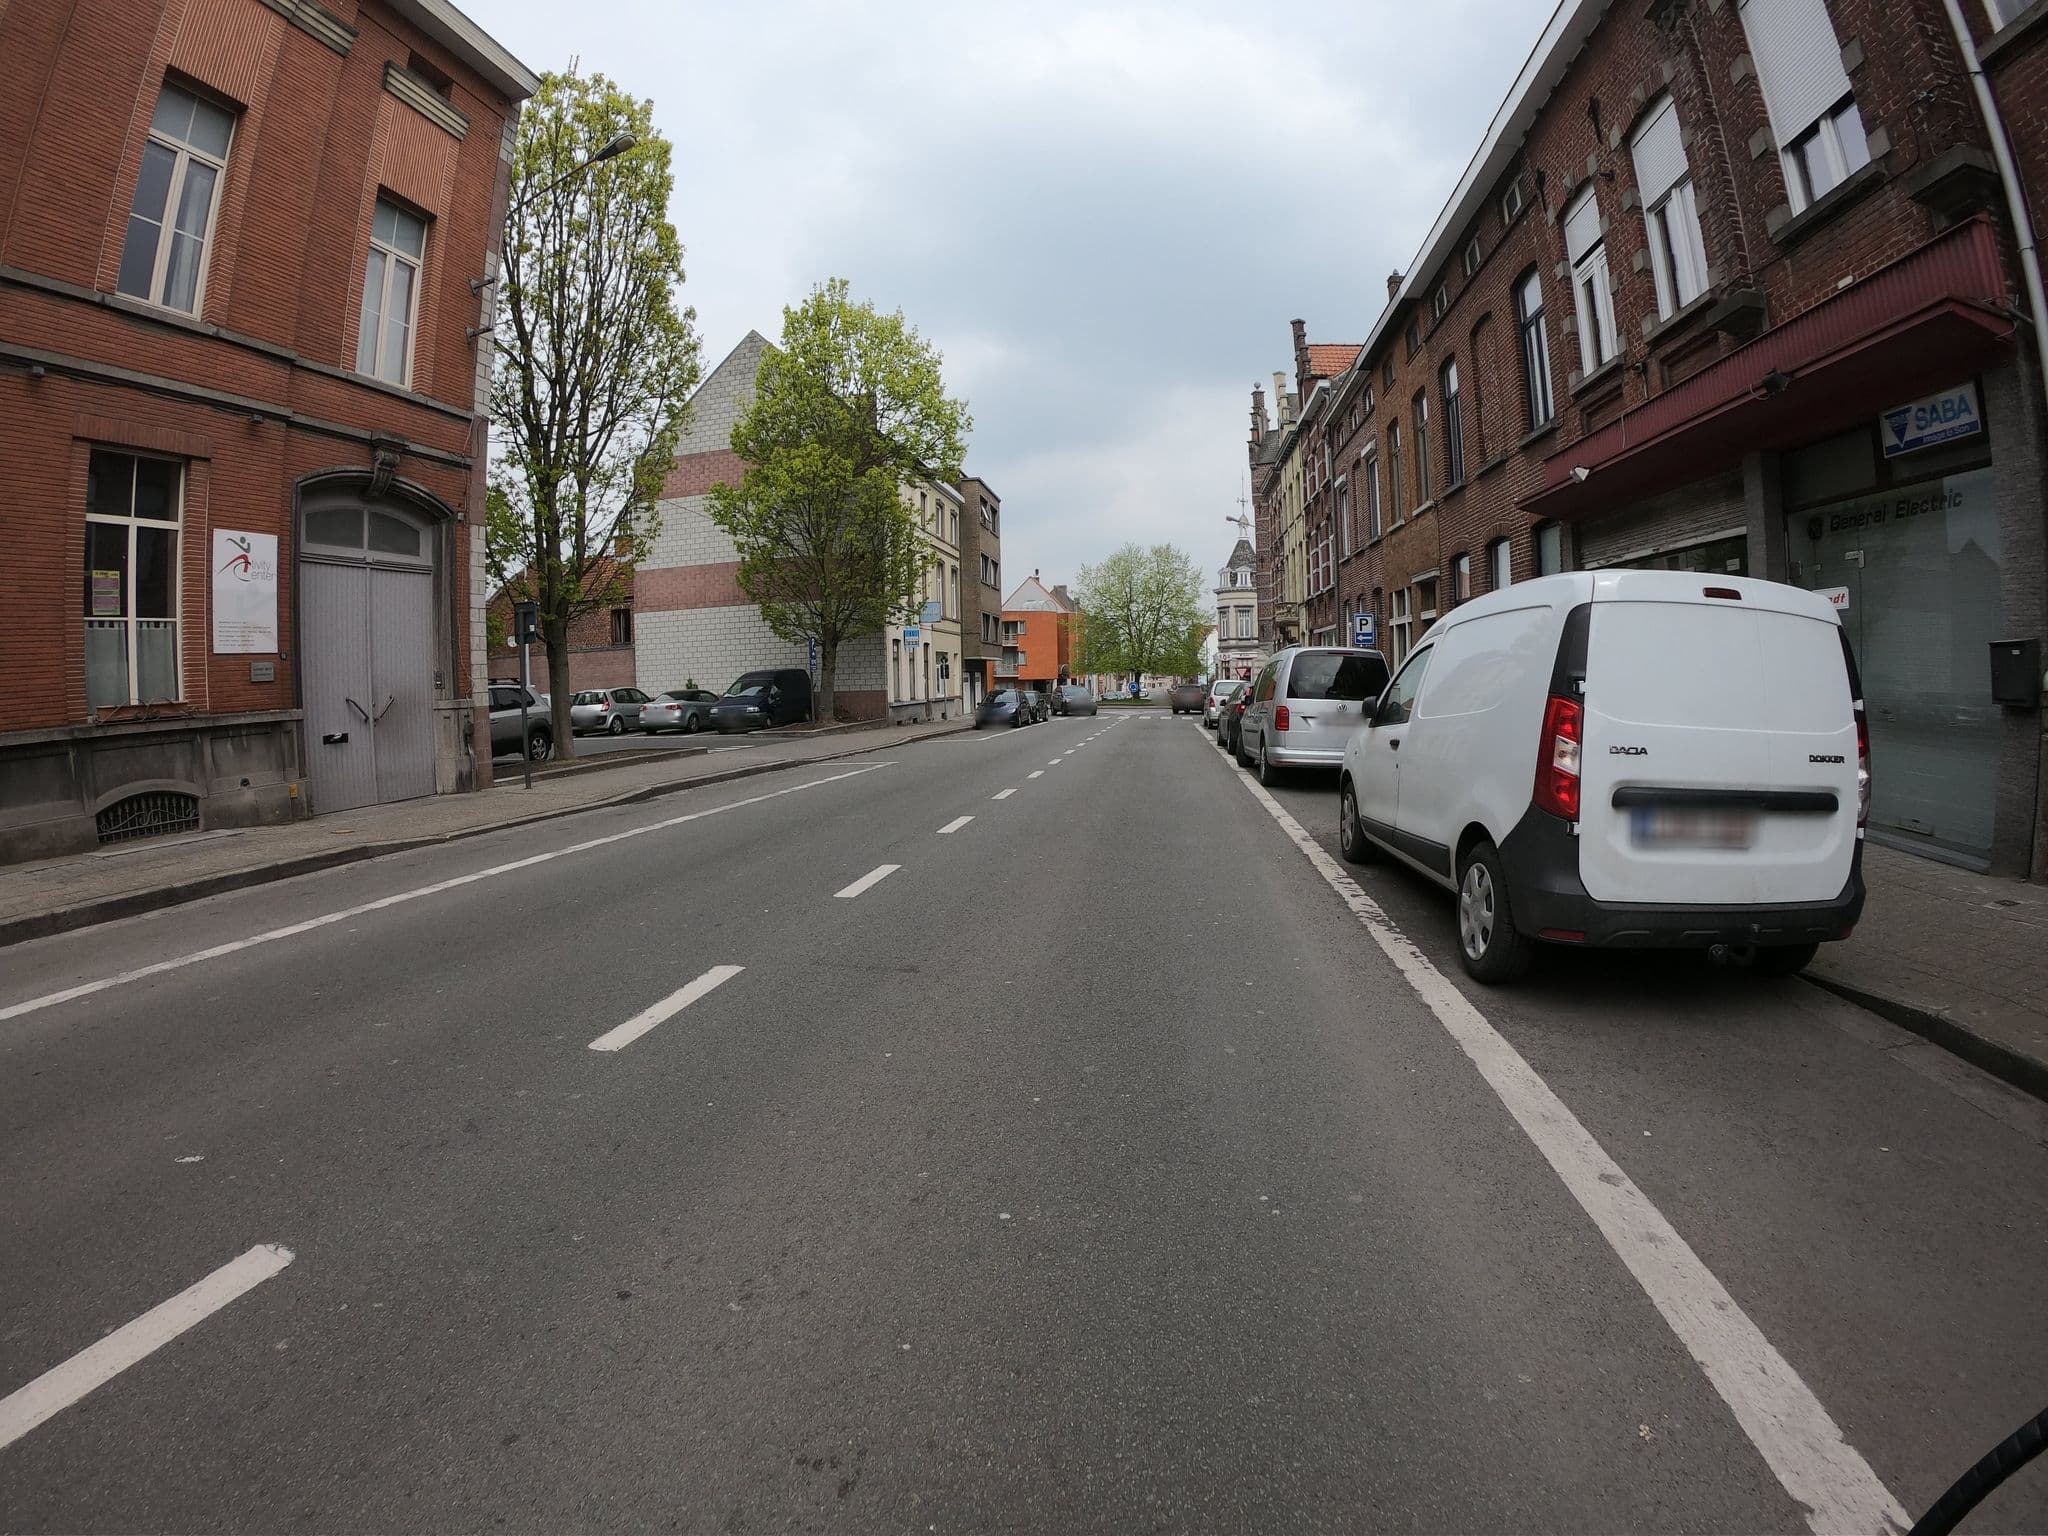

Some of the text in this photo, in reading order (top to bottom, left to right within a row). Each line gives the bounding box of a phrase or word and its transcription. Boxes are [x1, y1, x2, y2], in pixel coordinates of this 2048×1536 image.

[1915, 394, 1973, 430] SABA
[1830, 504, 1887, 532] General
[1896, 488, 1963, 519] Electric
[1359, 618, 1369, 632] P
[1609, 744, 1648, 756] DACIA
[1808, 754, 1845, 764] DOKKER
